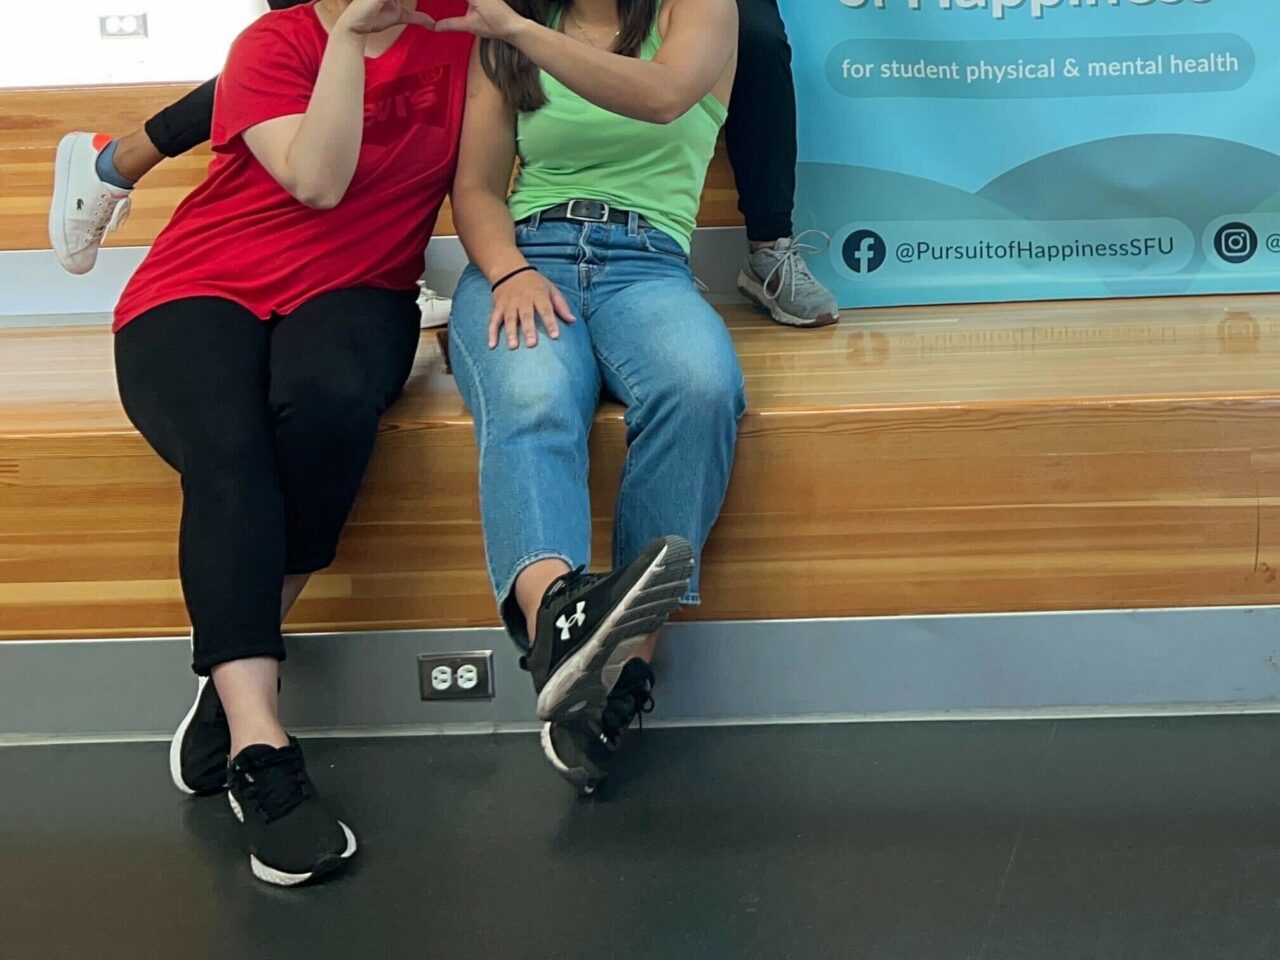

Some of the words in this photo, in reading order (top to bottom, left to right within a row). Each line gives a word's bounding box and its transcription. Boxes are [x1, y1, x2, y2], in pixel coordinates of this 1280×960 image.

[841, 58, 875, 79] for
[880, 58, 961, 80] student
[966, 58, 1056, 84] physical
[1062, 57, 1081, 78] &
[1087, 55, 1163, 77] mental
[1170, 52, 1239, 74] health
[895, 235, 1175, 264] @PursuitofHappinessSFU
